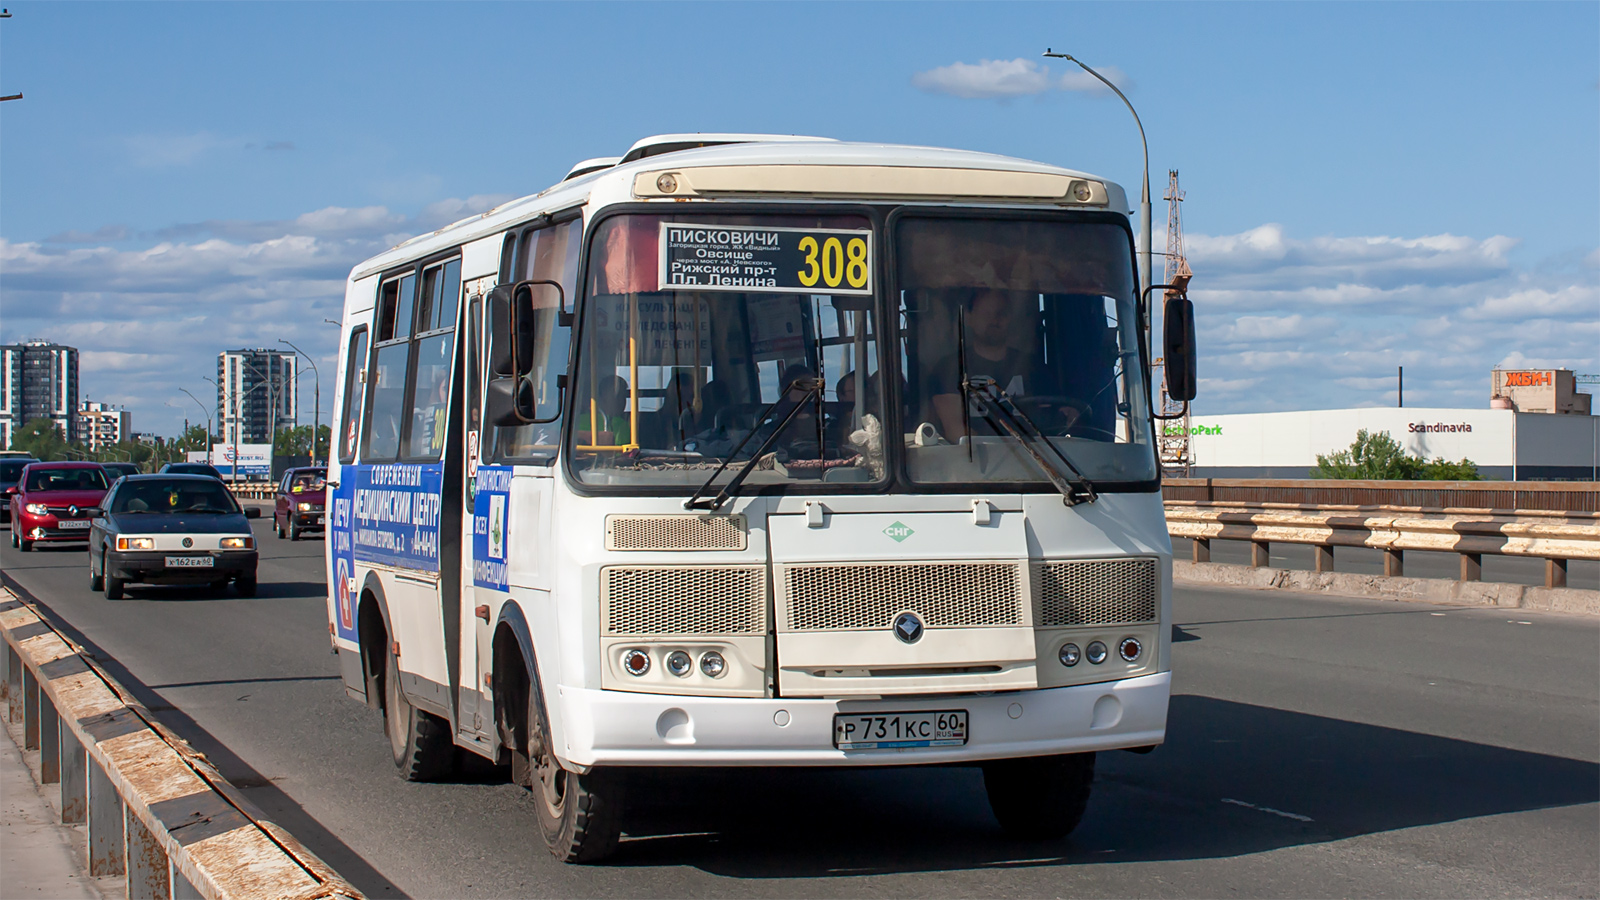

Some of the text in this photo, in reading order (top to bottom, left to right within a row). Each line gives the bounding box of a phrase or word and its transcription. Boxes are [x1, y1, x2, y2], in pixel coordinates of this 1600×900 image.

[670, 229, 779, 246] ПИСКОВИЧИ
[695, 249, 753, 260] Овсище
[797, 236, 868, 288] 308
[671, 262, 777, 277] Рижский пр-т
[672, 273, 777, 287] Пл. Ленина
[654, 340, 707, 350] ЛЕЧЕНЕ
[1506, 372, 1552, 387] ЖБИ-1
[1408, 421, 1472, 433] Scandinavia
[334, 498, 351, 528] ЛЕЧУ
[413, 492, 440, 531] ЦЕНТР
[475, 516, 488, 535] ВСЕХ
[885, 527, 910, 536] СНГ
[473, 558, 509, 590] ИНФЕКЦИЙ
[937, 714, 959, 731] 60
